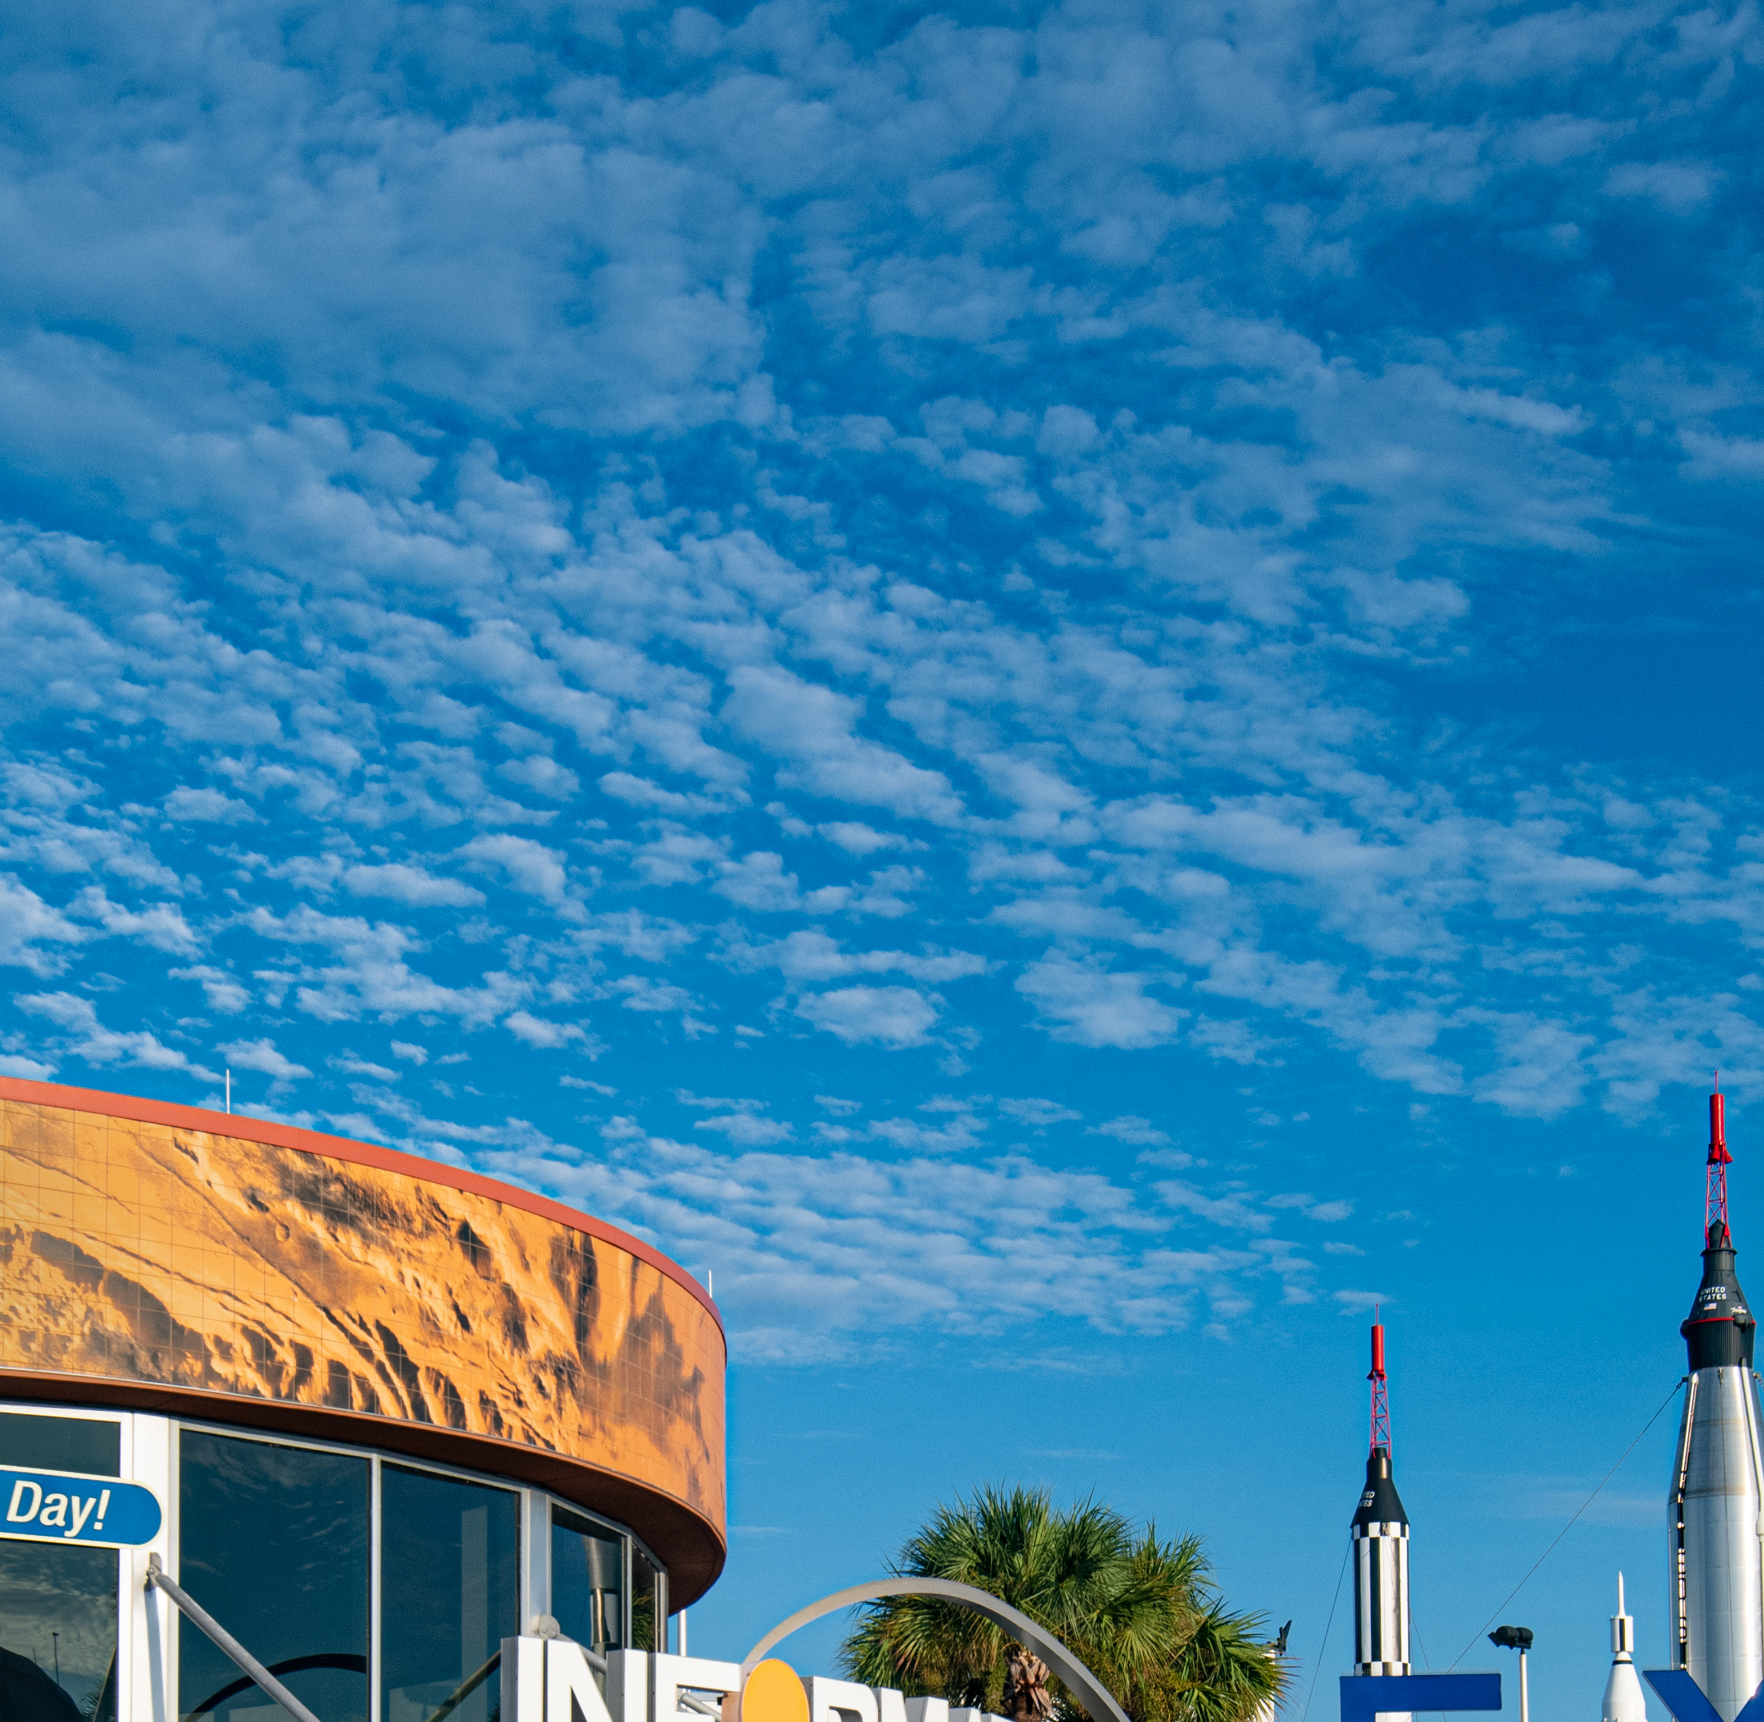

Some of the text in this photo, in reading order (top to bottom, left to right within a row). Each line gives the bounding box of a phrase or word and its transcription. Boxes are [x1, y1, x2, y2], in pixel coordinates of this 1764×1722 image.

[1700, 1286, 1726, 1295] UNITED
[1699, 1293, 1727, 1302] STATES
[6, 1480, 111, 1538] Day!
